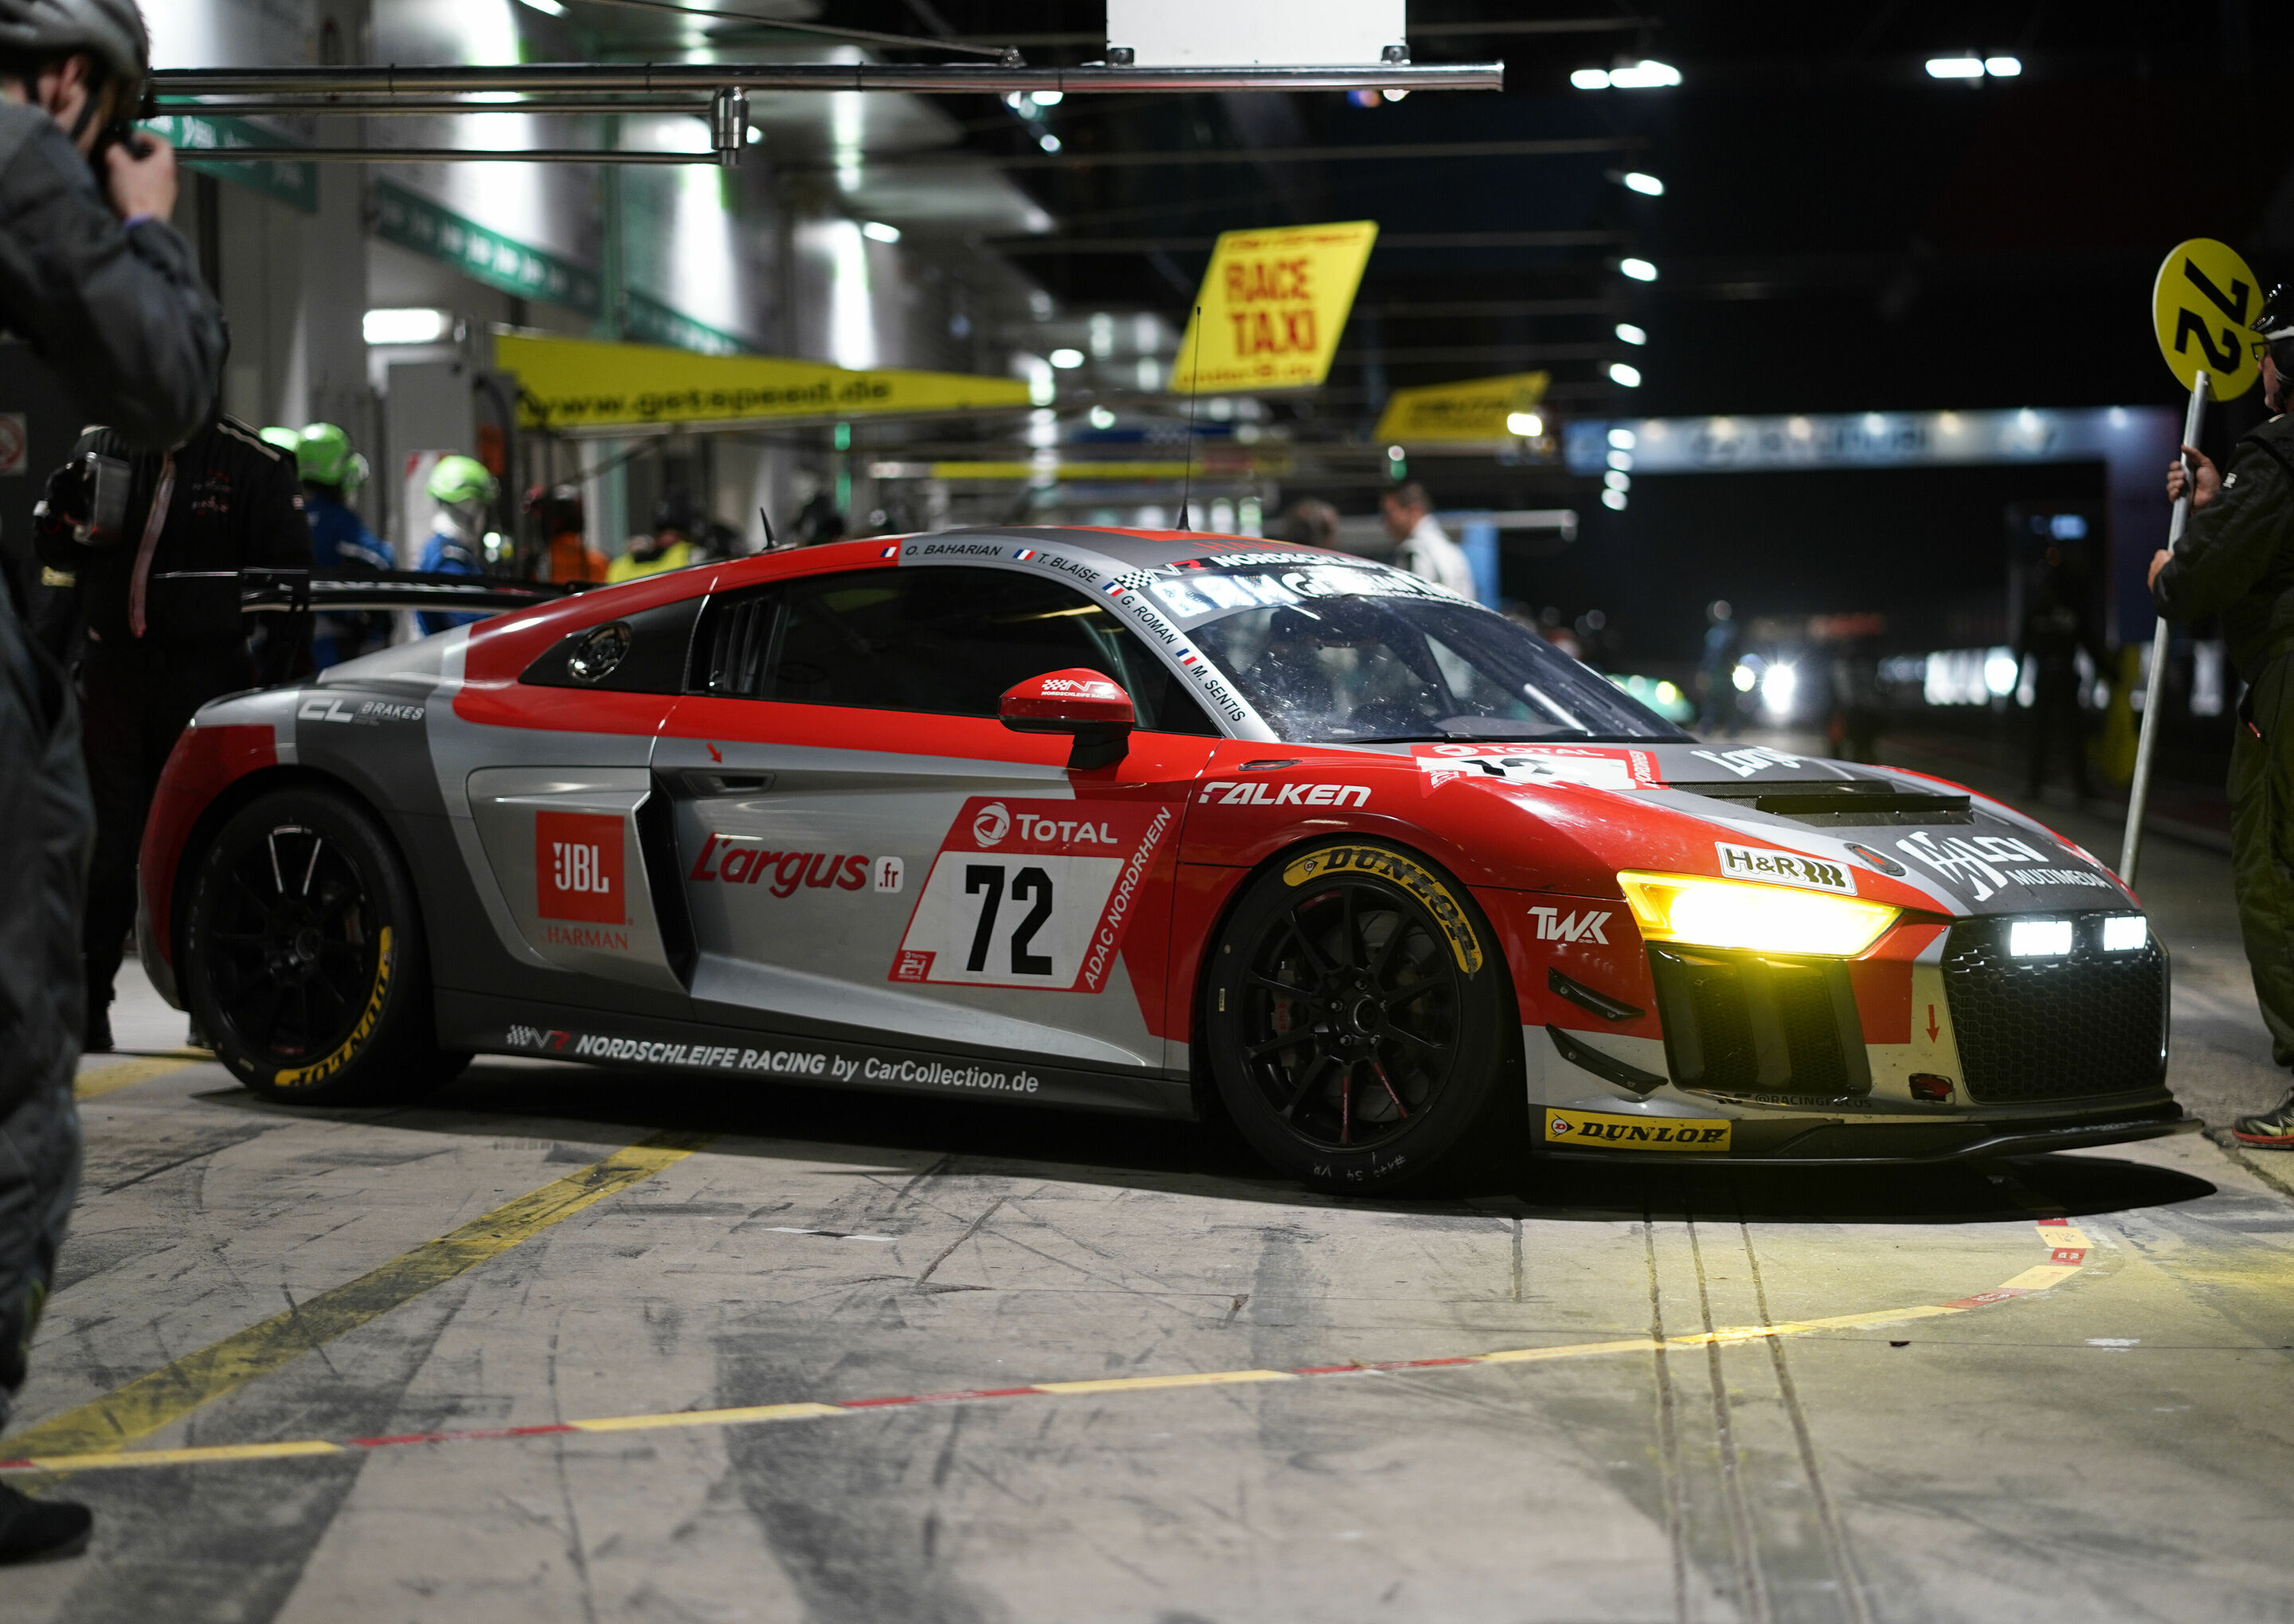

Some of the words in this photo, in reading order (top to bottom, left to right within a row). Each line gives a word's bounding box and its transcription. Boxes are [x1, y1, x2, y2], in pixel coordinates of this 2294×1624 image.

[1227, 256, 1310, 303] RACE
[1231, 310, 1317, 356] TAXI
[2175, 257, 2249, 375] 72
[905, 545, 919, 556] O.
[924, 544, 1003, 557] BAHARIAN
[1036, 553, 1047, 564] T.
[1050, 556, 1100, 584] BLAISE
[1121, 595, 1135, 609] G.
[1133, 606, 1178, 644] ROMAN
[297, 697, 354, 723] CL
[360, 701, 425, 721] BRAKES
[1191, 665, 1208, 681] M.
[1204, 679, 1246, 722] SENTIS
[1478, 745, 1605, 757] TOTAL
[1197, 781, 1372, 807] FALKEN
[1016, 813, 1118, 844] TOTAL
[553, 842, 609, 894] JBL
[690, 832, 871, 898] L'argus
[1724, 847, 1800, 877] H&R
[2005, 869, 2112, 890] MULTIMEDIA
[1084, 927, 1115, 990] ADAC
[1110, 805, 1172, 929] NORDRHEIN
[1323, 847, 1477, 951] DUNLOP
[547, 925, 628, 950] HARMAN
[965, 864, 1053, 976] 72
[575, 1035, 738, 1068] NORDSCHLEIFE
[739, 1047, 826, 1074] RACING
[832, 1055, 859, 1082] by
[864, 1057, 1039, 1093] CarCollection.de
[1578, 1121, 1728, 1144] DUNLOP
